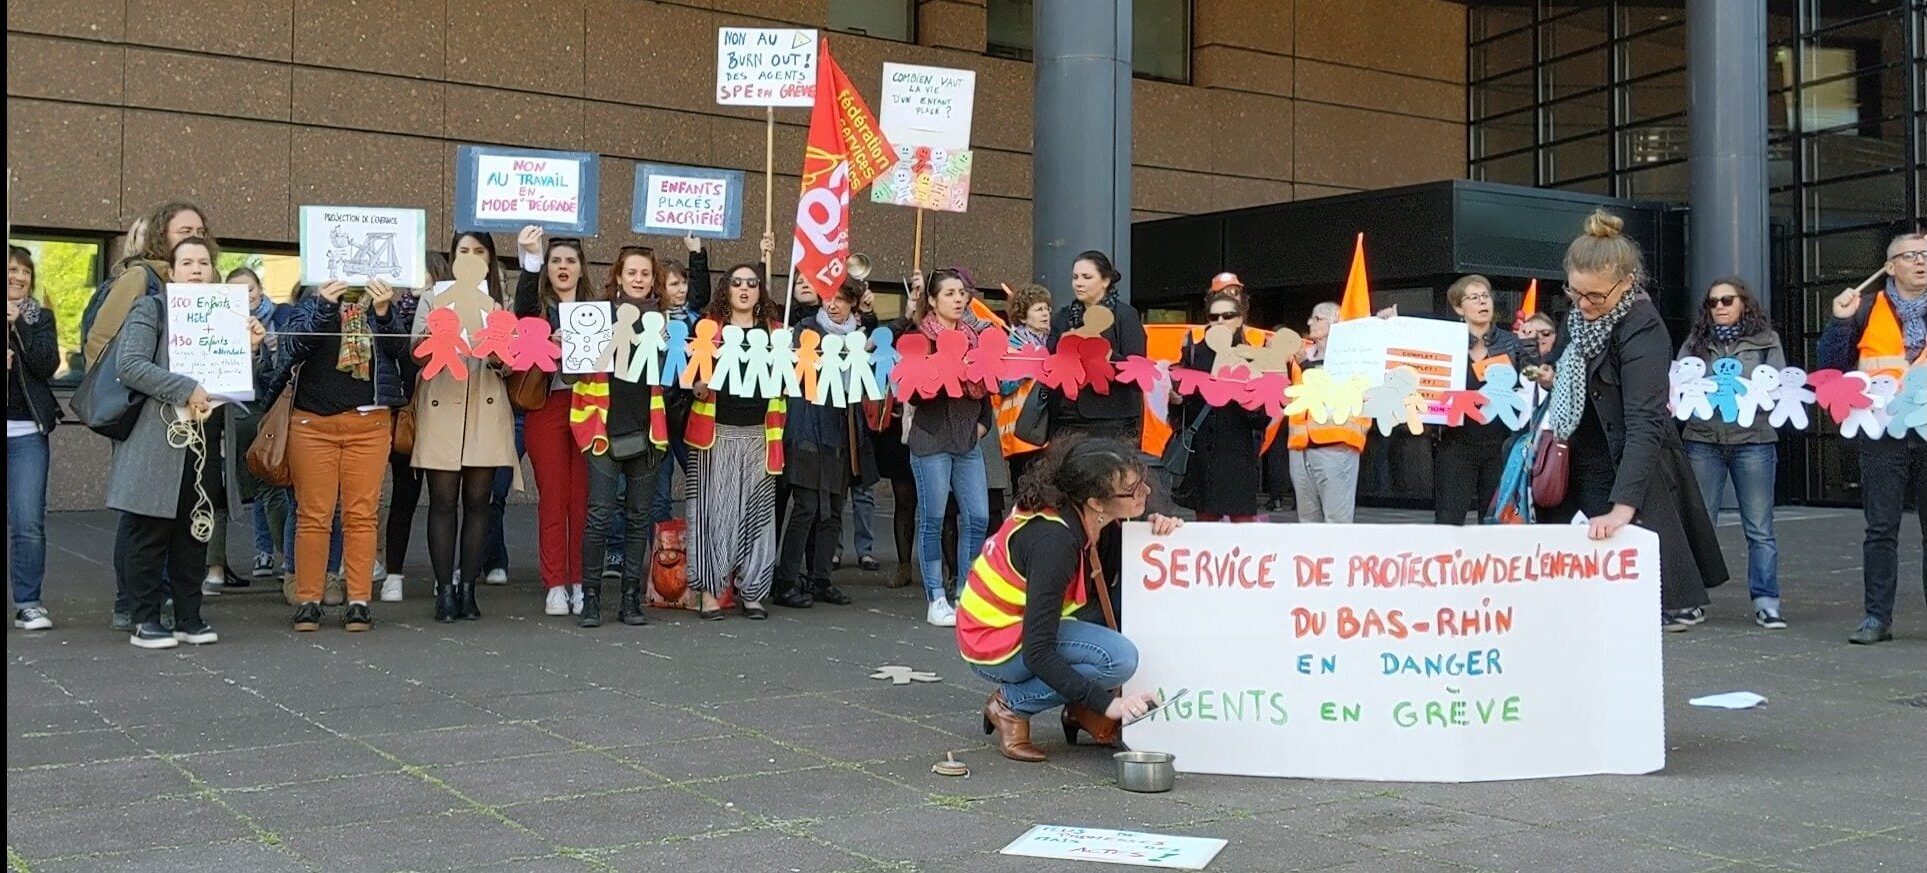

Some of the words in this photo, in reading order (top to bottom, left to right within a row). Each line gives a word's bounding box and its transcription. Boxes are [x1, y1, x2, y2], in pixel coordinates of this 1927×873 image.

[724, 30, 747, 46] NON
[757, 32, 778, 46] AU
[727, 51, 762, 69] BURN
[726, 71, 747, 81] DES
[758, 70, 806, 81] AGENTS
[892, 72, 933, 85] COMBIEN
[941, 77, 965, 87] VAUT
[720, 83, 754, 100] SPE
[909, 85, 920, 93] LA
[926, 86, 940, 94] VIE
[920, 97, 952, 106] ENFANT
[838, 89, 890, 169] fédération
[513, 160, 547, 171] NON
[487, 172, 509, 186] AU
[517, 173, 568, 187] TRAVAIL
[519, 187, 536, 196] EN
[661, 181, 724, 196] ENFANTS
[481, 199, 518, 212] MODE
[658, 196, 711, 209] PLACÉS
[324, 213, 360, 222] PROJECTION
[171, 296, 192, 309] 100
[197, 296, 231, 313] Enfants
[170, 334, 193, 346] 130
[1293, 555, 1335, 588] DE
[1348, 548, 1492, 588] PROTECTION
[1290, 607, 1327, 639] DU
[1297, 653, 1337, 675] EN
[1380, 648, 1503, 677] DANGER
[1150, 687, 1288, 726] AGENTS
[1320, 702, 1361, 722] EN
